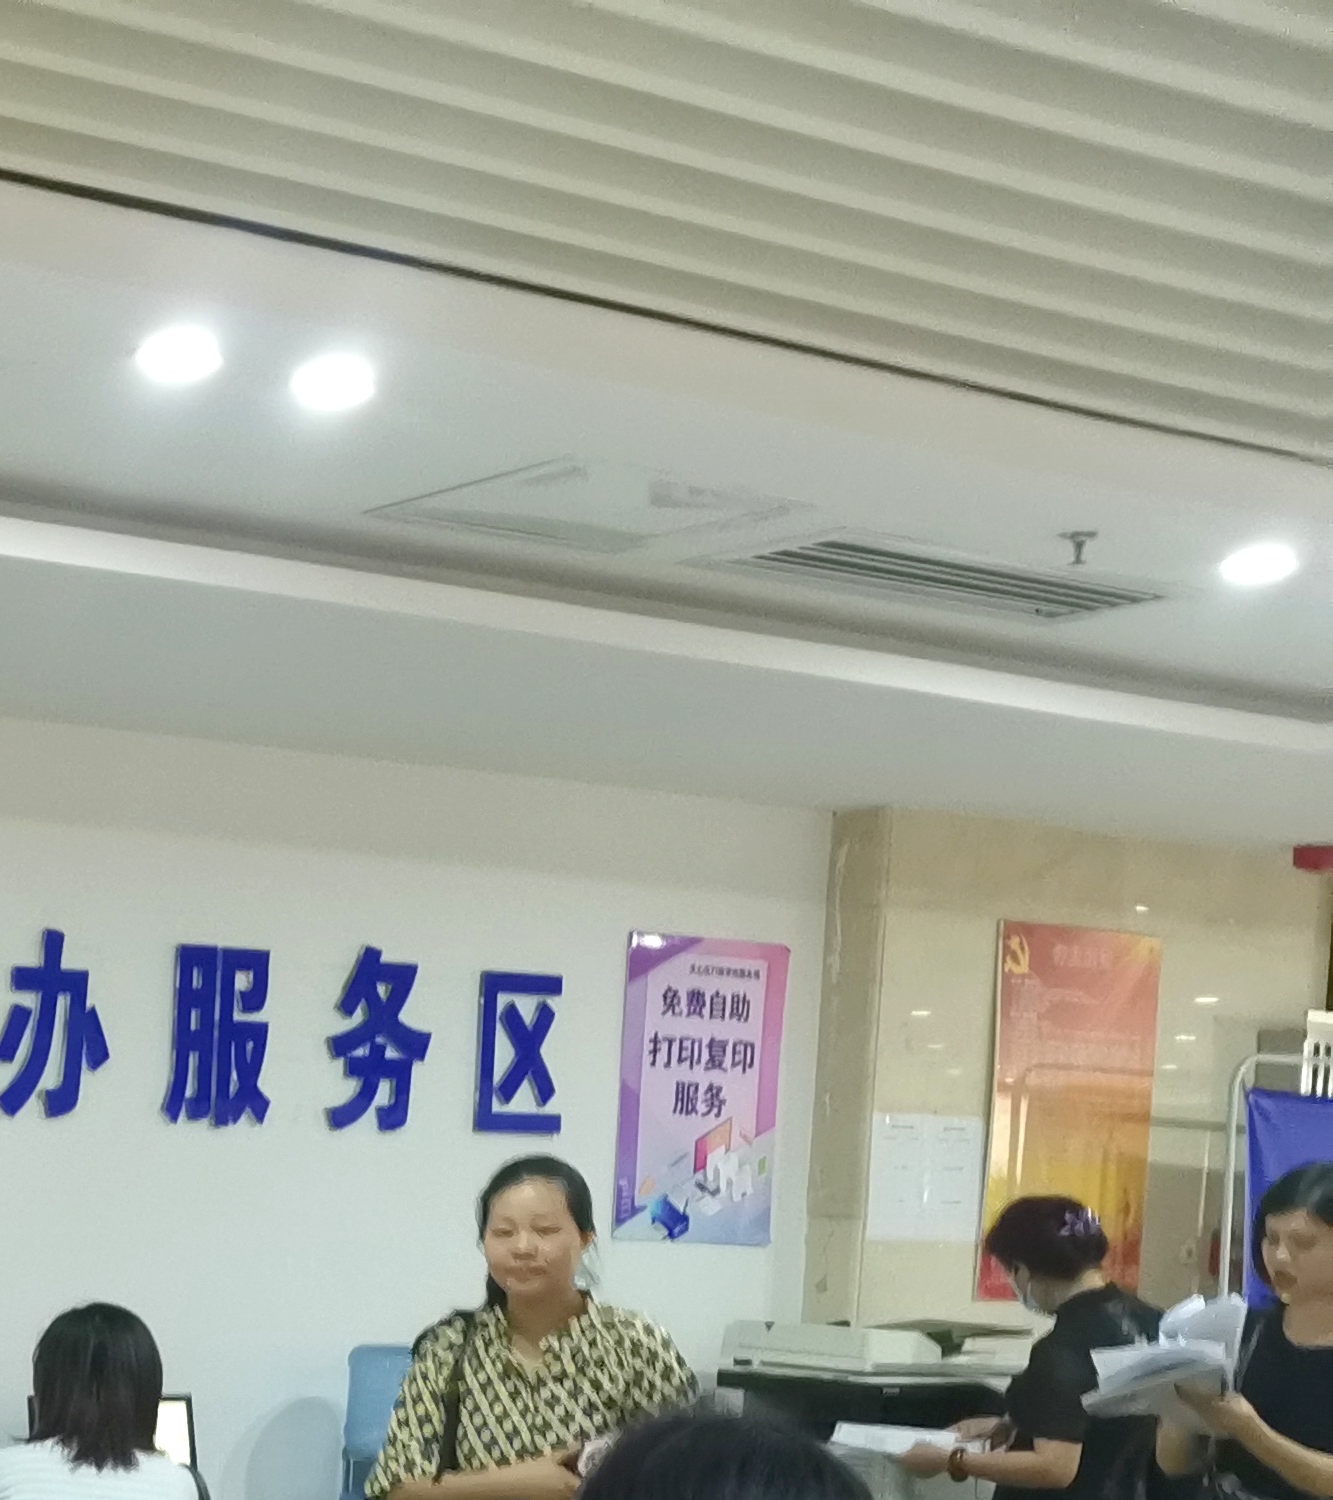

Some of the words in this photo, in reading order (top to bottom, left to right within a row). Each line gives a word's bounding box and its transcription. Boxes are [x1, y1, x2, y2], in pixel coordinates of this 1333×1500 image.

[661, 984, 751, 1023] 免费自助
[648, 1031, 756, 1074] 打印复印
[672, 1080, 728, 1118] 服务
